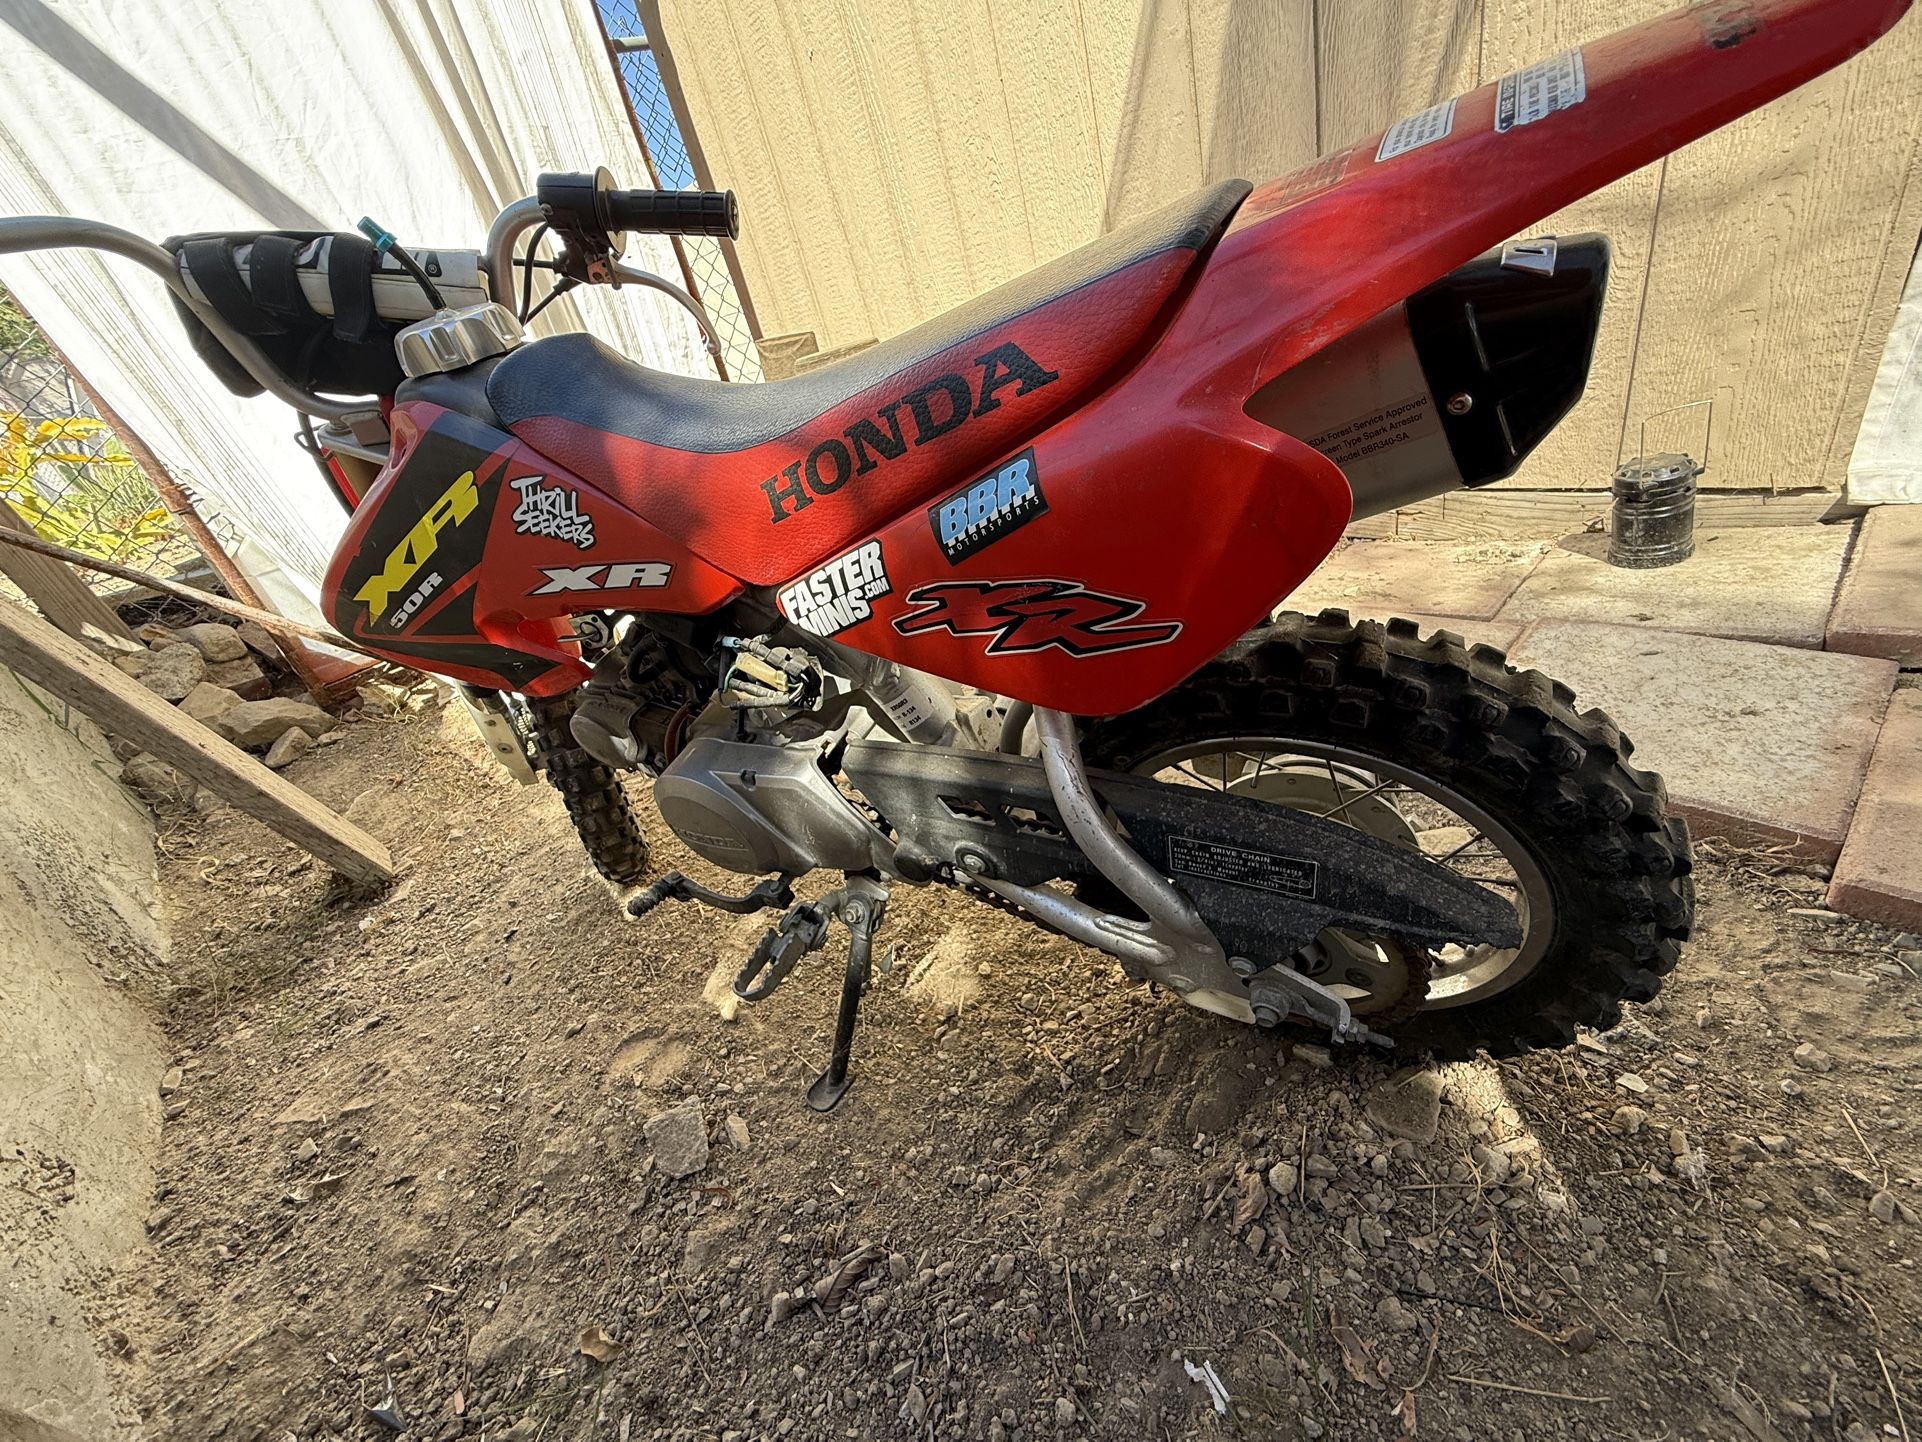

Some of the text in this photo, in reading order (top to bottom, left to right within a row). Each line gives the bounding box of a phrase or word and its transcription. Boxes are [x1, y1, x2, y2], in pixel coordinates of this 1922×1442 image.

[759, 341, 1059, 524] HONDA
[1320, 412, 1423, 456] creen Type Spark Arrestor
[1327, 427, 1352, 441] Forest
[1353, 416, 1384, 432] Service
[1385, 396, 1428, 419] Approved
[1335, 432, 1410, 464] Model BBR340-SA
[512, 503, 594, 549] SEEKERS
[940, 458, 1030, 545] BBR
[948, 496, 1040, 556] MOTORSPORTS
[352, 470, 479, 628] XR
[389, 571, 443, 629] 50R
[529, 562, 673, 596] XR
[780, 541, 884, 625] FASTER
[891, 578, 1183, 657] XR
[1210, 846, 1271, 863] DRIVE CHAIN
